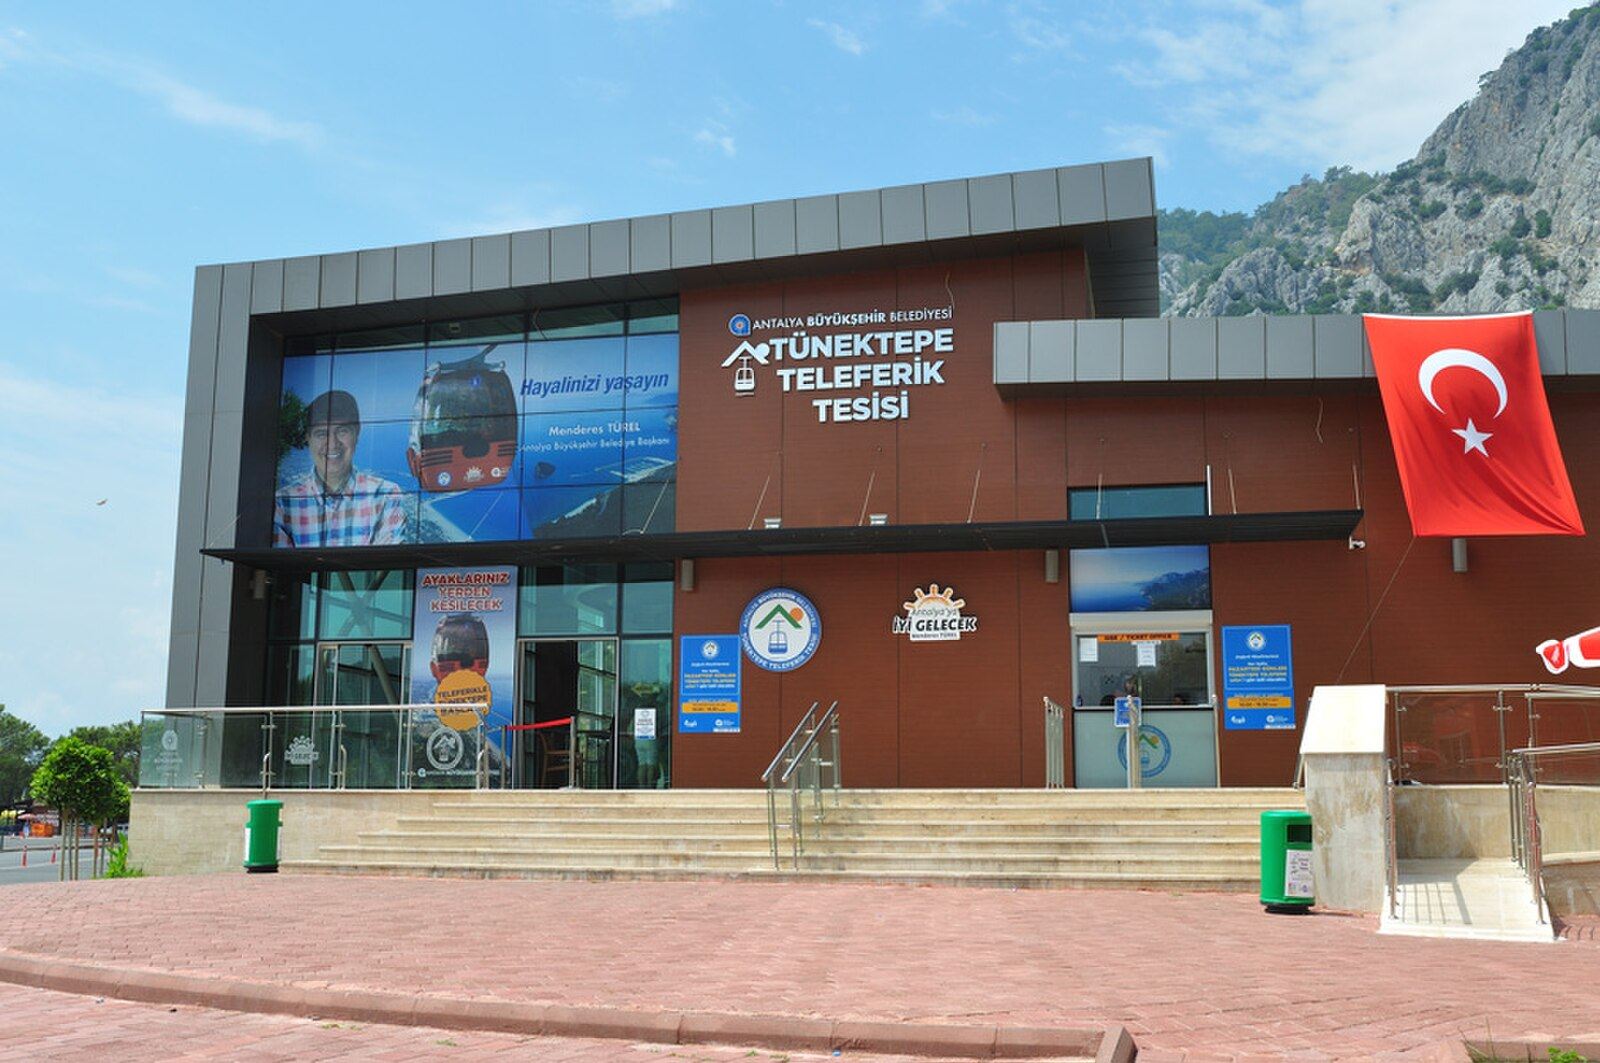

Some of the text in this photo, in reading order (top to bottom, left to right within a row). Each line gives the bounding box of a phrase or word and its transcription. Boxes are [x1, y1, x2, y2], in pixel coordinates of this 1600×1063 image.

[752, 305, 953, 331] ANTALYA BÜYÜKŞEHİR BELEDİYESİ
[769, 328, 954, 361] TÜNEKTEPE
[520, 373, 670, 398] Hayalinizi yaşayın
[777, 356, 945, 391] TELEFERİK
[812, 390, 909, 423] TESİSİ
[549, 420, 641, 437] Menderes TÜREL
[423, 572, 511, 586] AYAKLARINIZ
[437, 585, 492, 598] YERDEN
[915, 617, 975, 632] GELECEK
